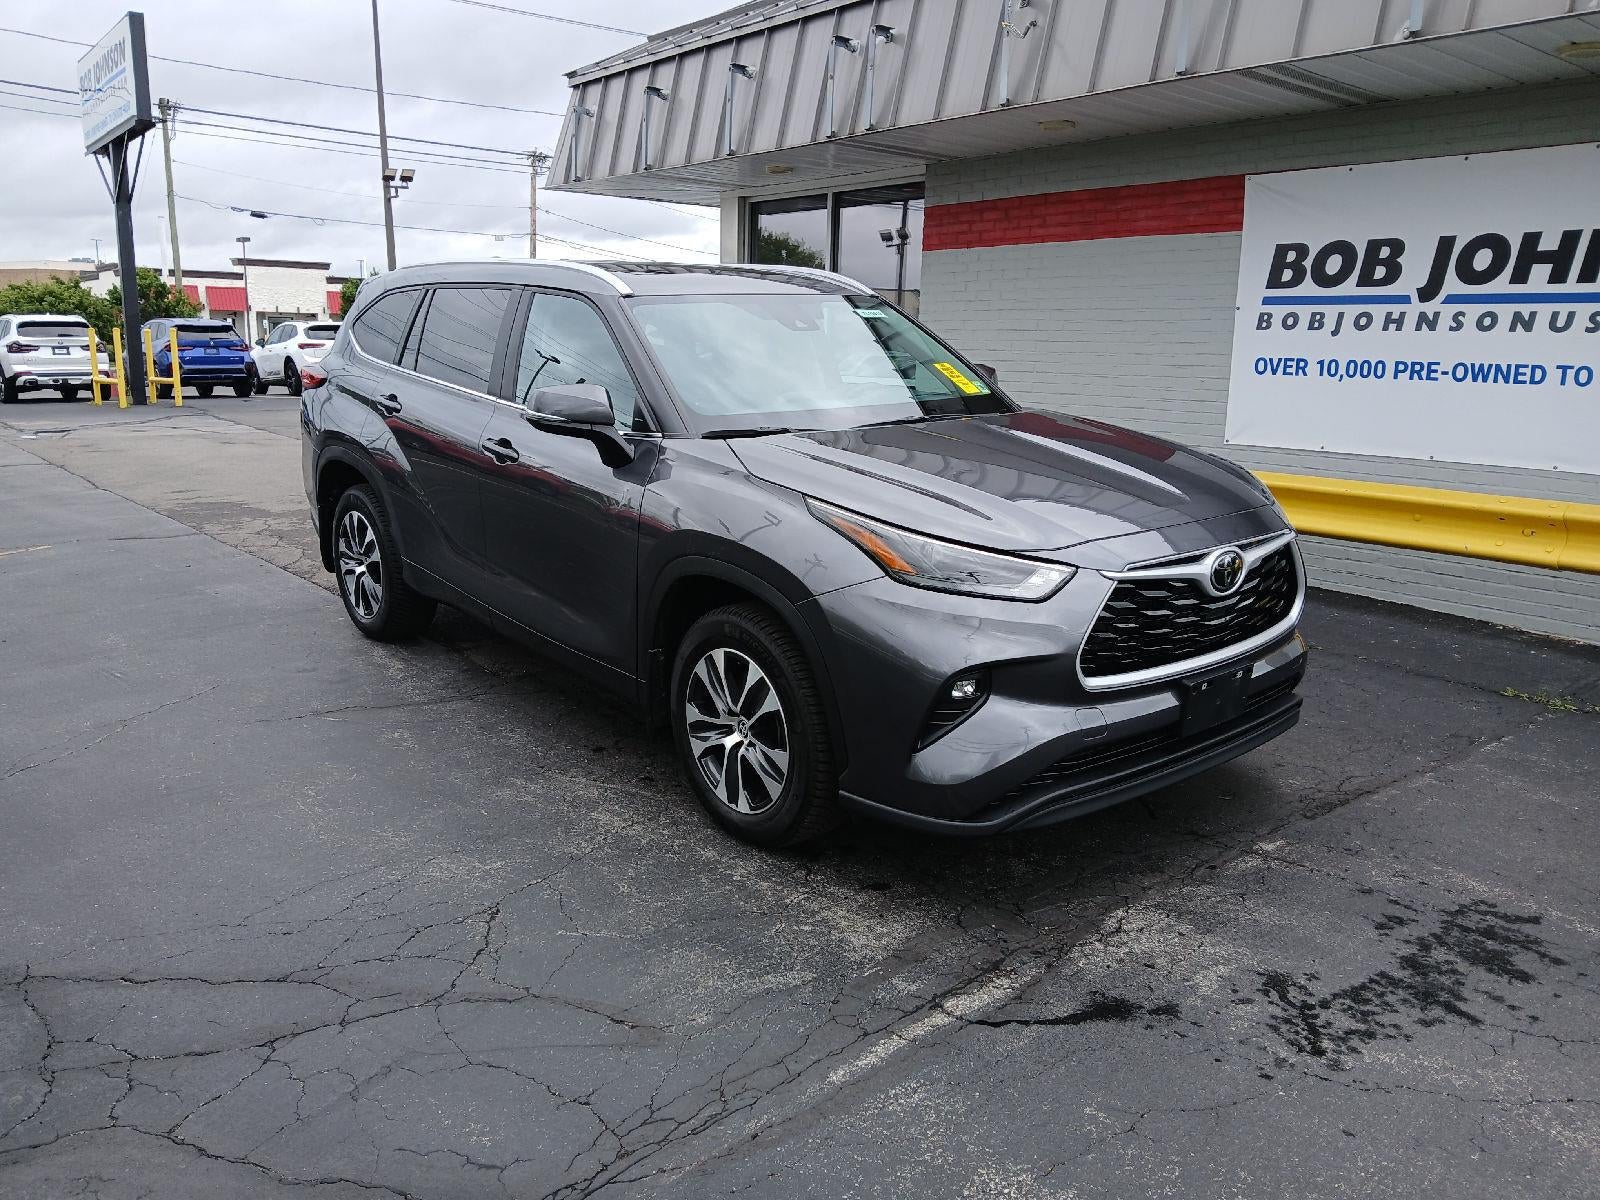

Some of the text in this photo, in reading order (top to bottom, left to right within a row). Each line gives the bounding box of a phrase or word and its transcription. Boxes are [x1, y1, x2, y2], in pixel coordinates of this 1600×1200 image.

[93, 36, 126, 93] JOHNSON
[1265, 237, 1406, 290] BOB
[1254, 357, 1594, 388] OVER 10,000 PRE-OWNED TO
